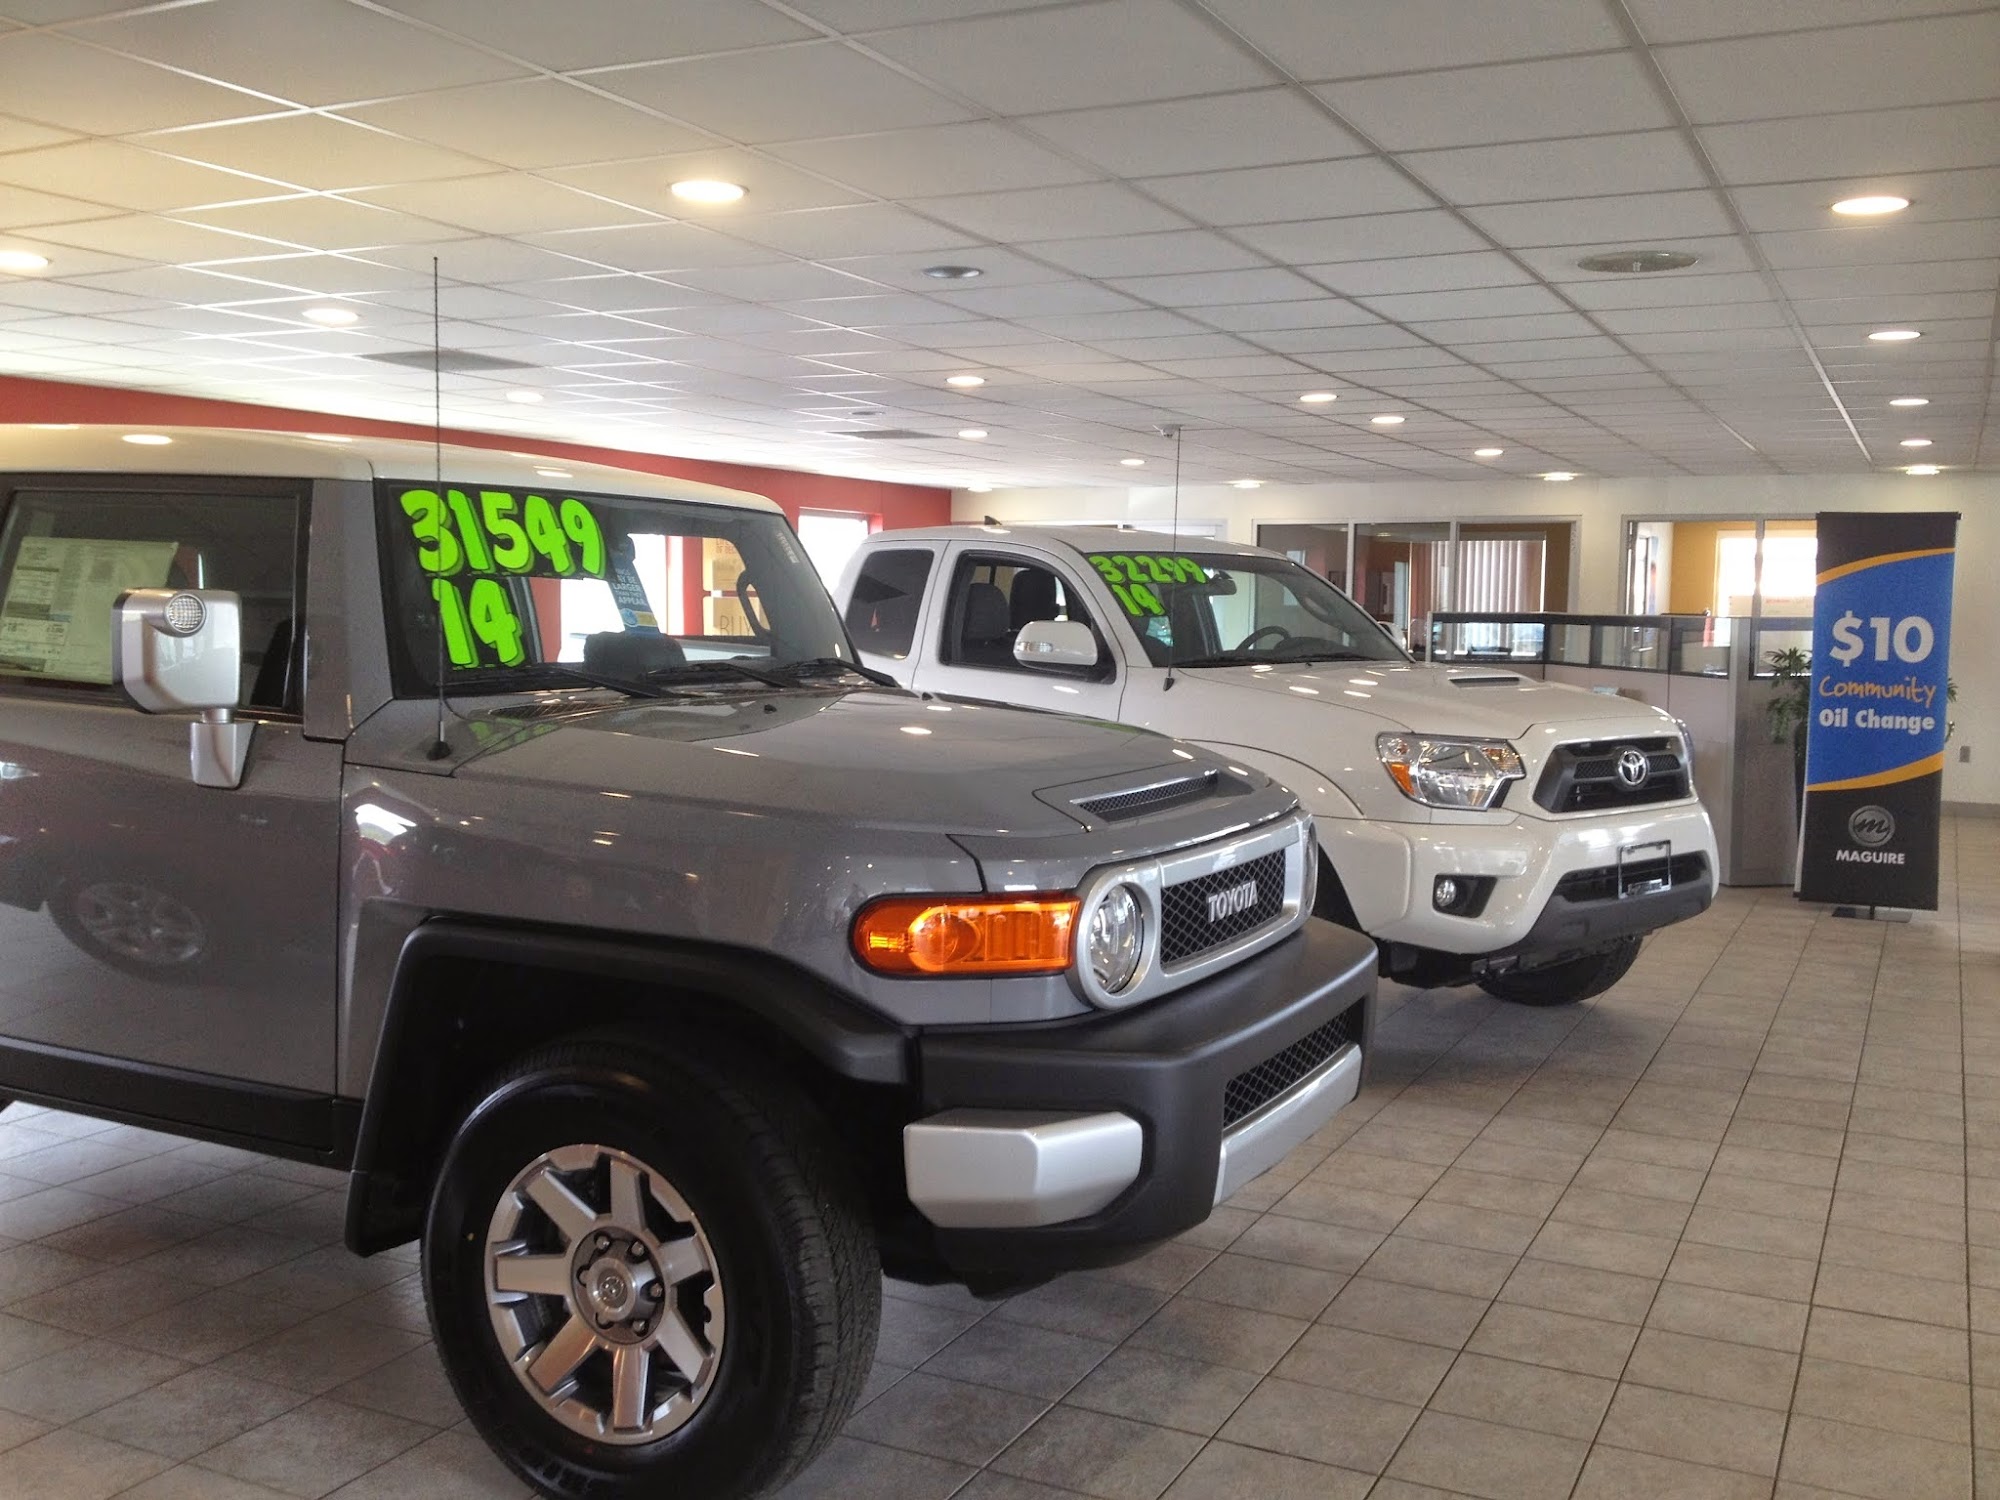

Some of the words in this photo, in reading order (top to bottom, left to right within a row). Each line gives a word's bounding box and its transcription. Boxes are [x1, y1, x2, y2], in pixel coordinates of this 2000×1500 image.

[401, 489, 606, 578] 31549
[1089, 555, 1207, 583] 32299
[1112, 583, 1165, 616] 14
[432, 578, 526, 669] 14
[1829, 610, 1934, 667] $10
[1819, 675, 1937, 708] Community
[1819, 708, 1848, 728] Oil
[1855, 708, 1936, 735] Change
[1835, 849, 1905, 865] MAGUIRE
[1207, 880, 1258, 923] TOYOTA
